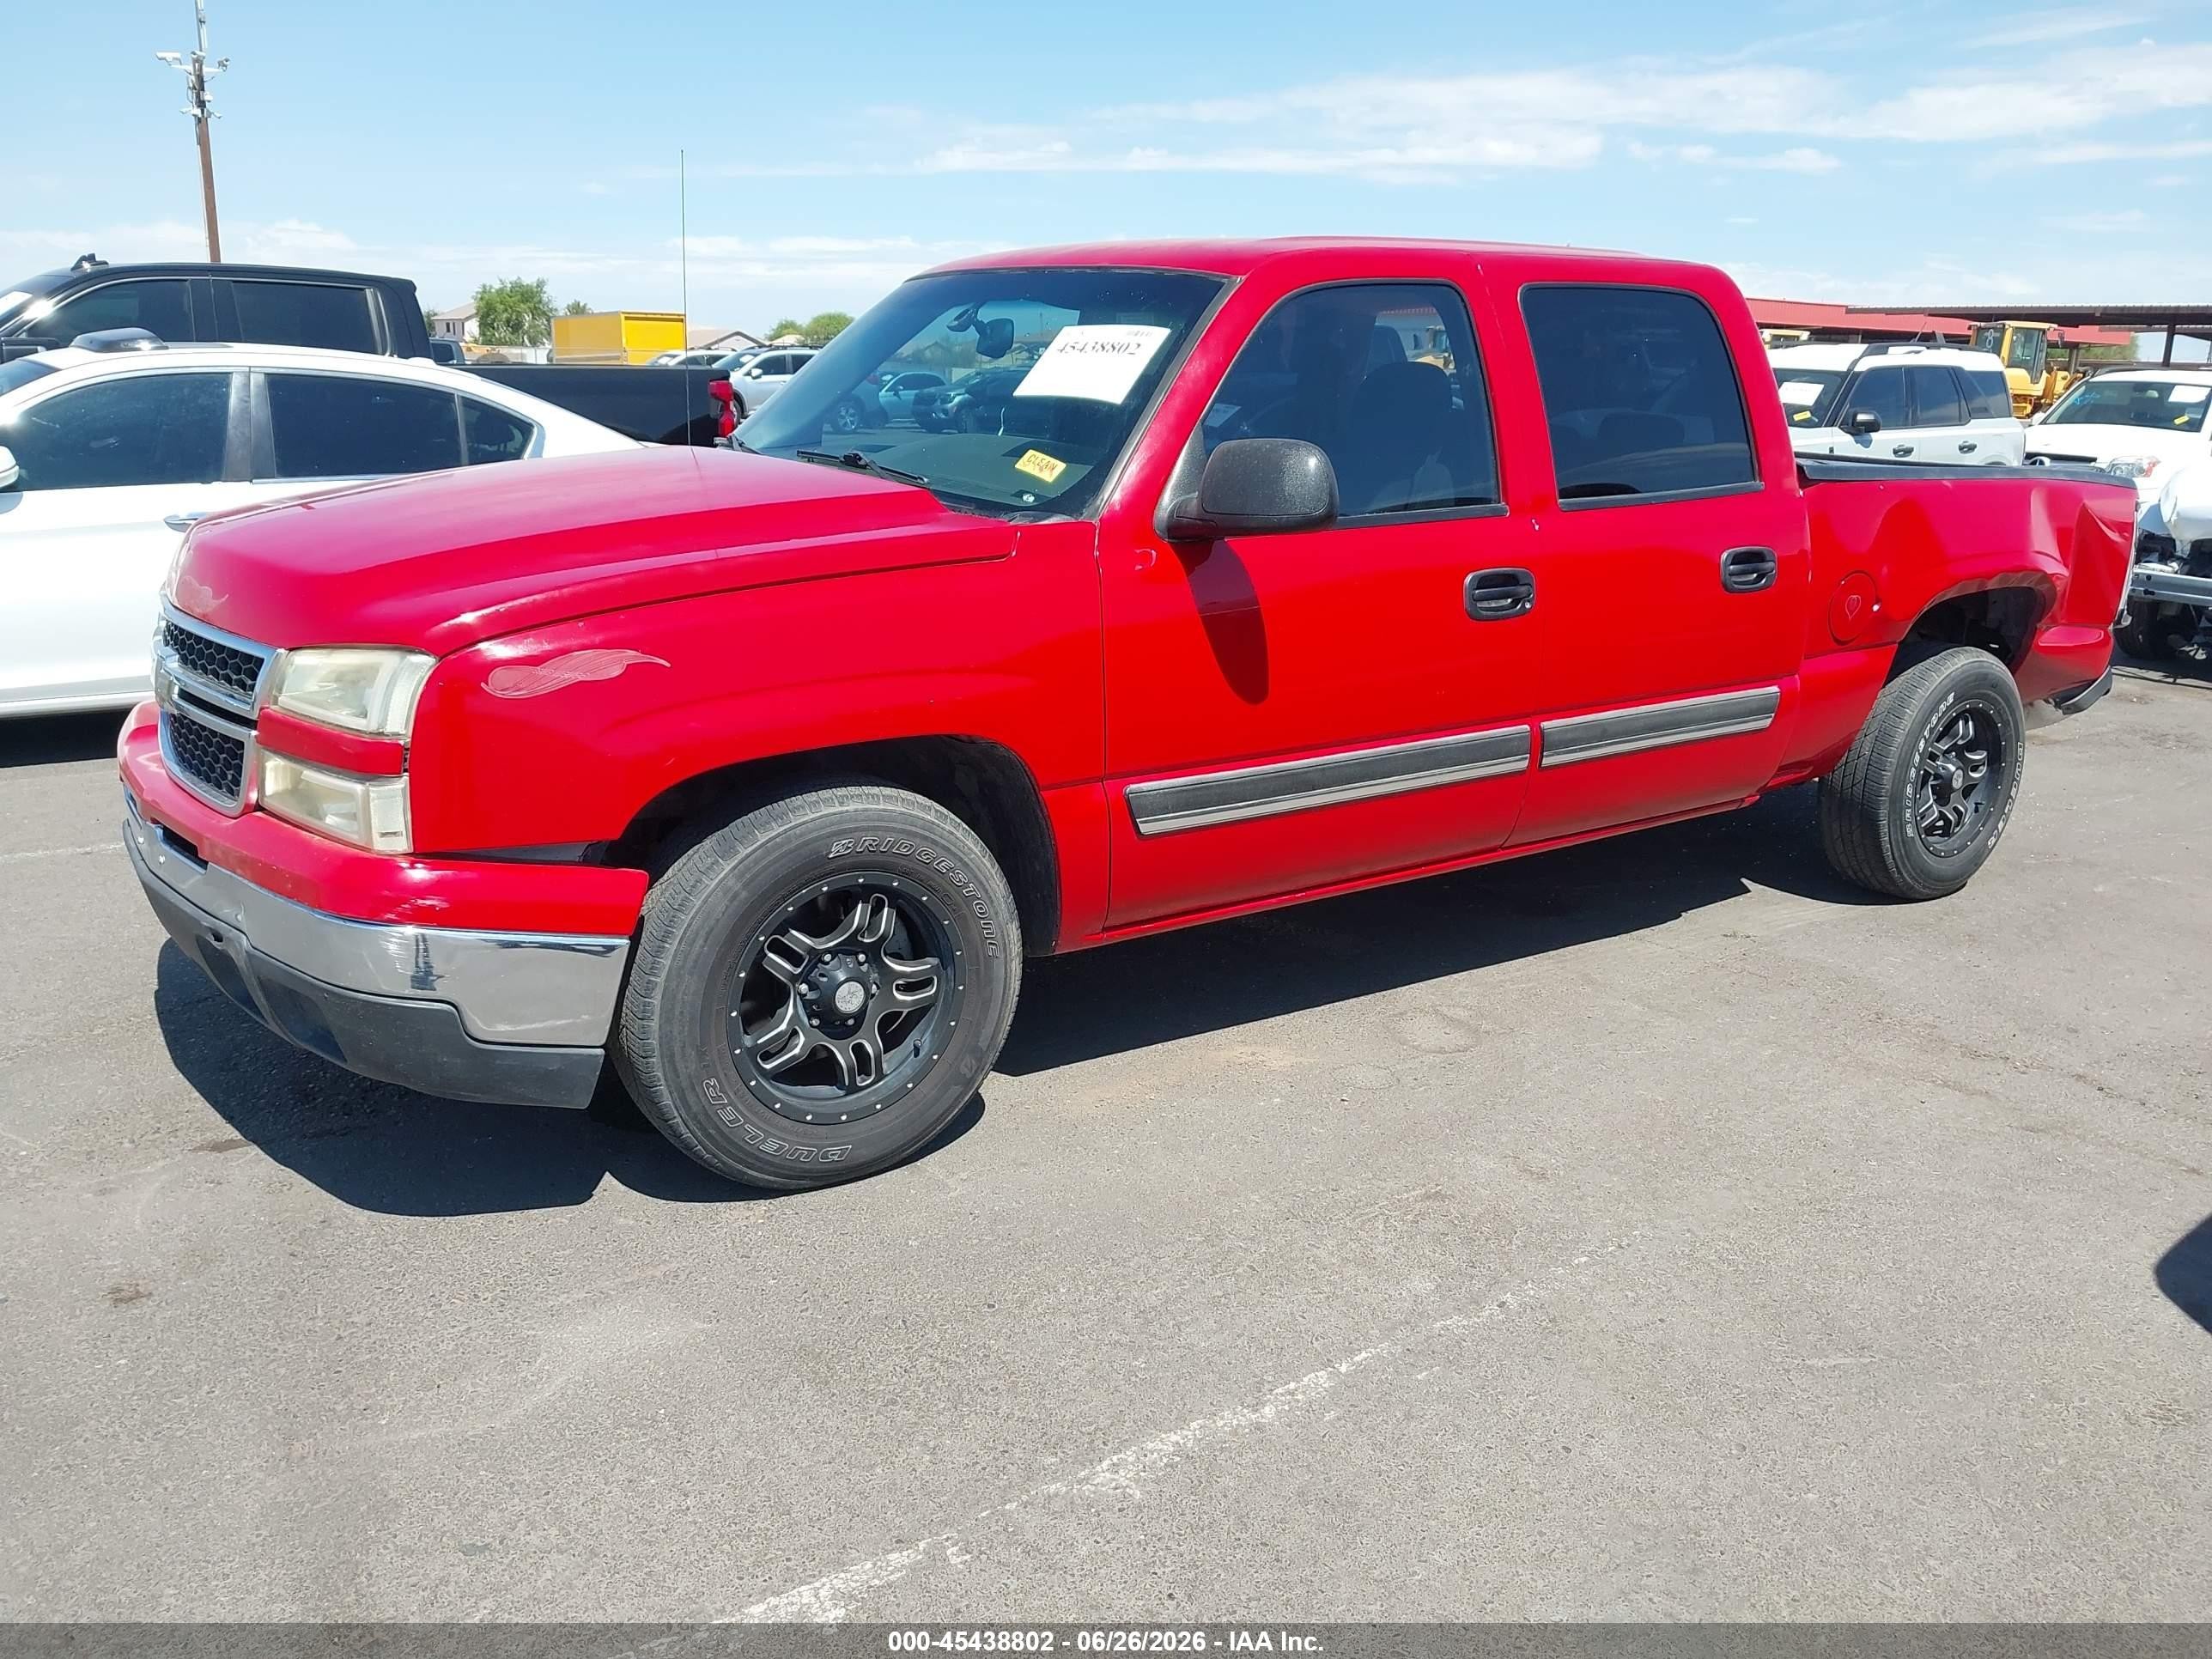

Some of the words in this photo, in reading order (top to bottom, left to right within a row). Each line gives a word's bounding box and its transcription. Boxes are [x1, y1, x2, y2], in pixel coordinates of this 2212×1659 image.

[1057, 341, 1141, 355] 45438802
[1905, 691, 1955, 838] BRIDGESTONE
[827, 836, 1002, 958] BRIDGESTONE
[702, 1077, 853, 1163] DUELER
